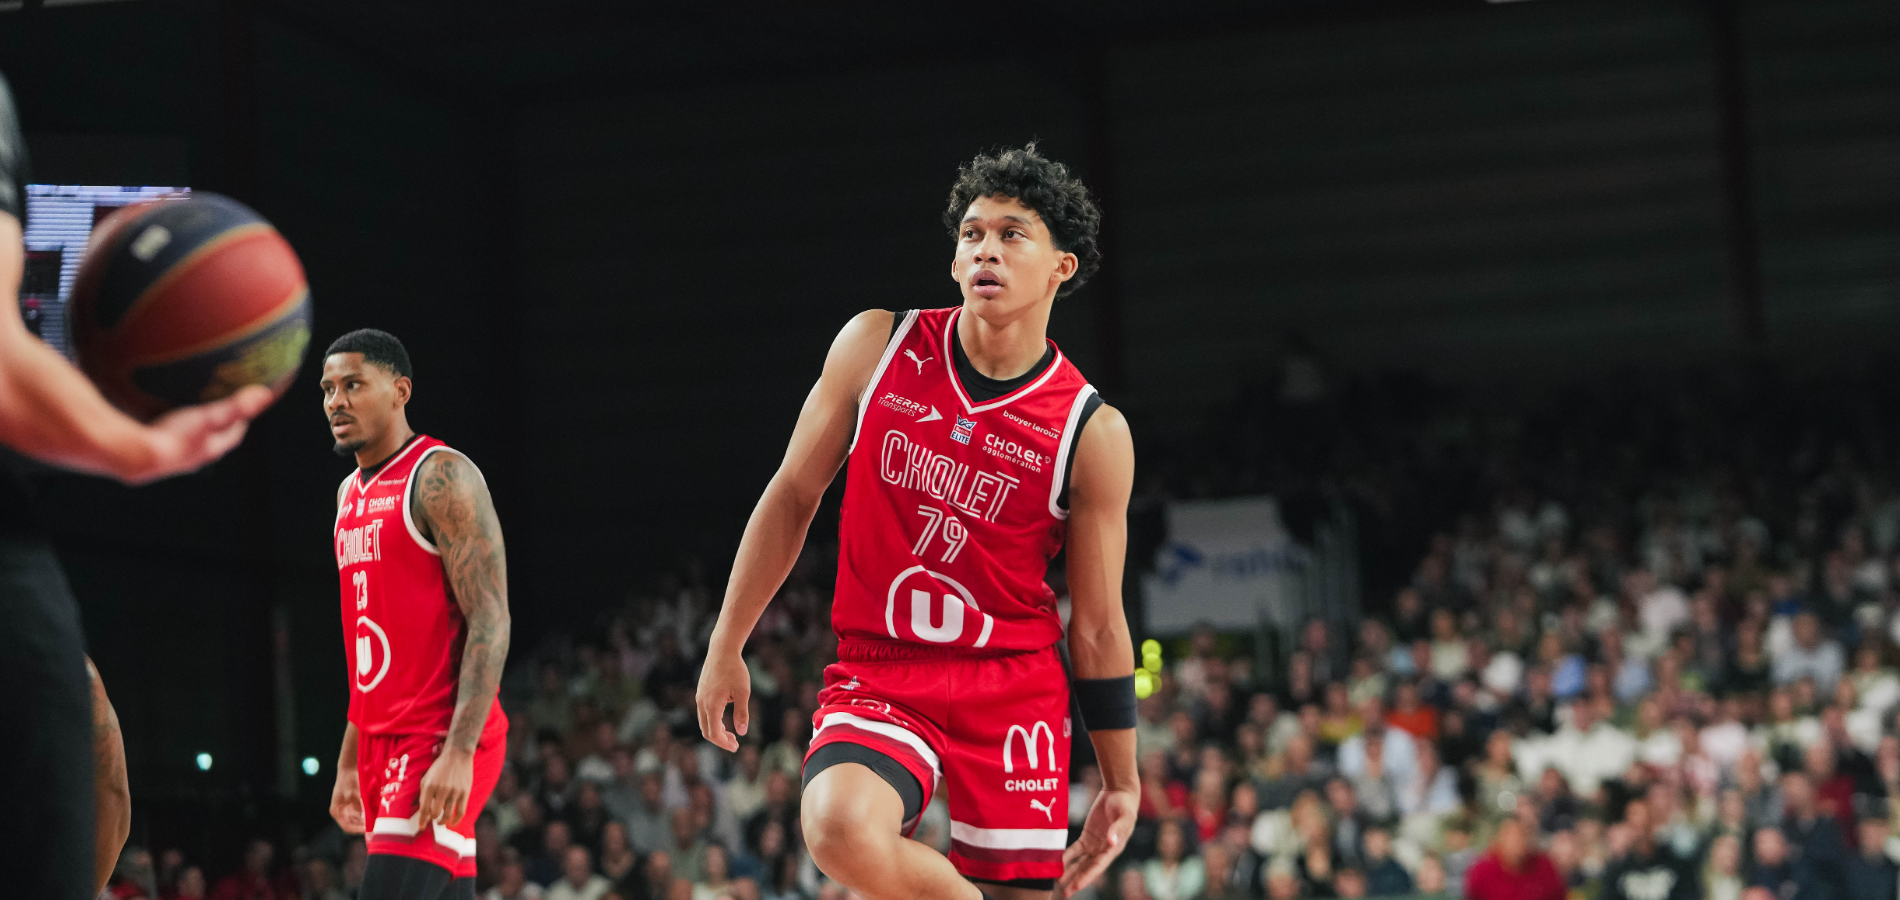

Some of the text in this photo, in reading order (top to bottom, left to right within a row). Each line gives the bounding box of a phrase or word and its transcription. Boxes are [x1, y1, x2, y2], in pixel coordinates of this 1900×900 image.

[877, 396, 917, 417] Transports
[951, 431, 970, 445] ELITE
[1003, 410, 1060, 439] bouyer leroux
[880, 429, 1021, 524] CHOLET
[982, 445, 1042, 473] agglomération
[336, 518, 384, 571] CHOLET
[911, 504, 969, 564] 79
[352, 570, 368, 612] 23
[911, 588, 965, 643] U
[1005, 777, 1059, 792] CHOLET
